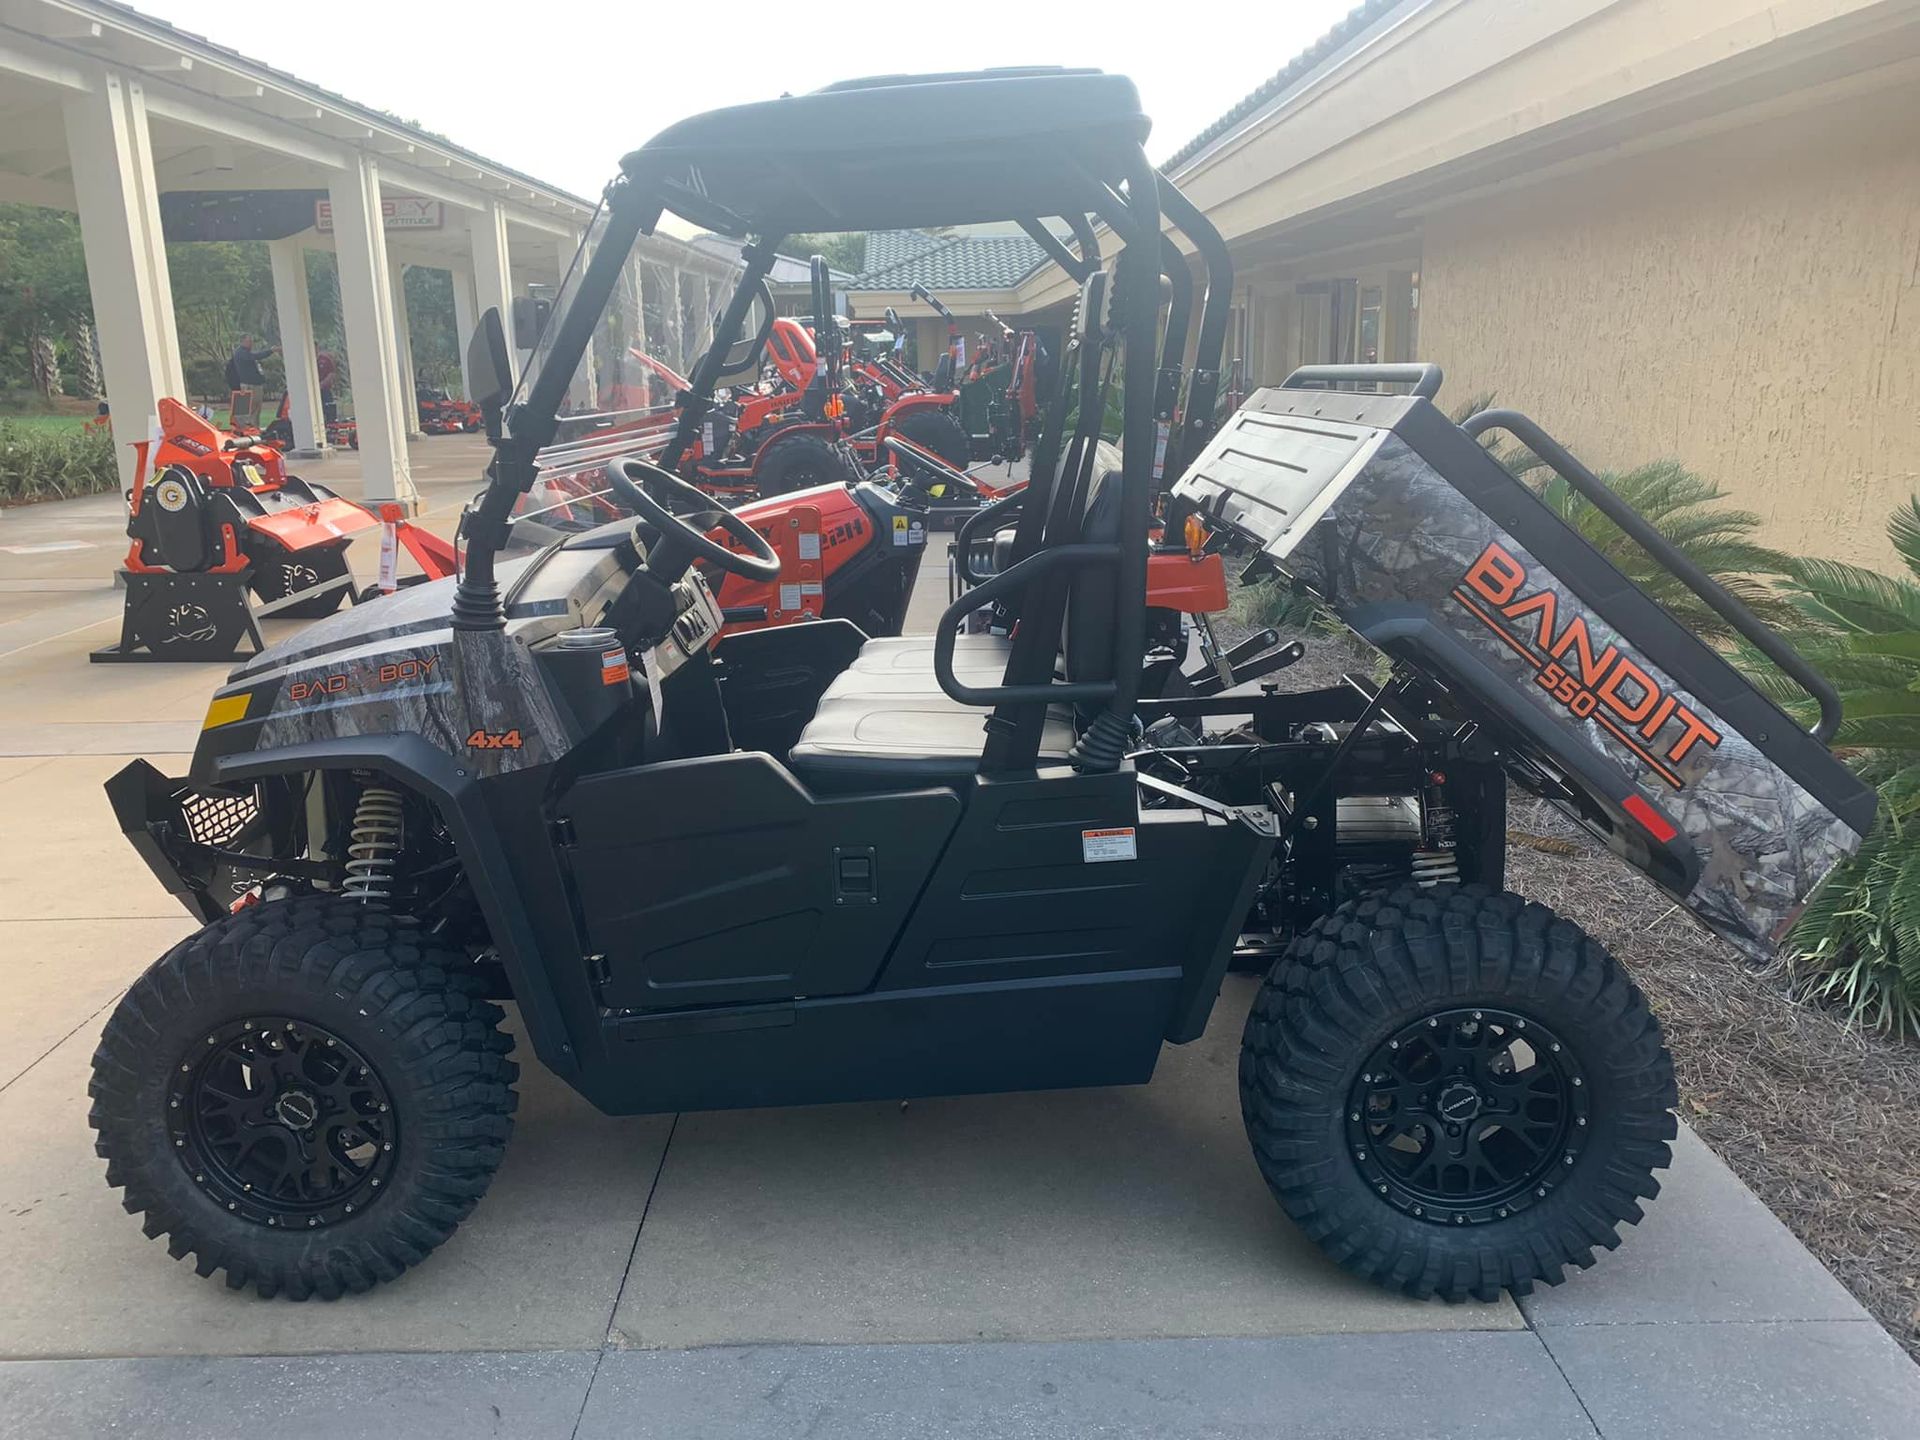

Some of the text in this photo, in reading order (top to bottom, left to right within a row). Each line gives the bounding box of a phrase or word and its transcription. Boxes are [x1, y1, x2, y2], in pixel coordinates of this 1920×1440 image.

[291, 653, 439, 700] BAD BOY
[1464, 541, 1724, 766] BANDIT
[1534, 662, 1598, 717] 550
[467, 729, 523, 749] 4x4
